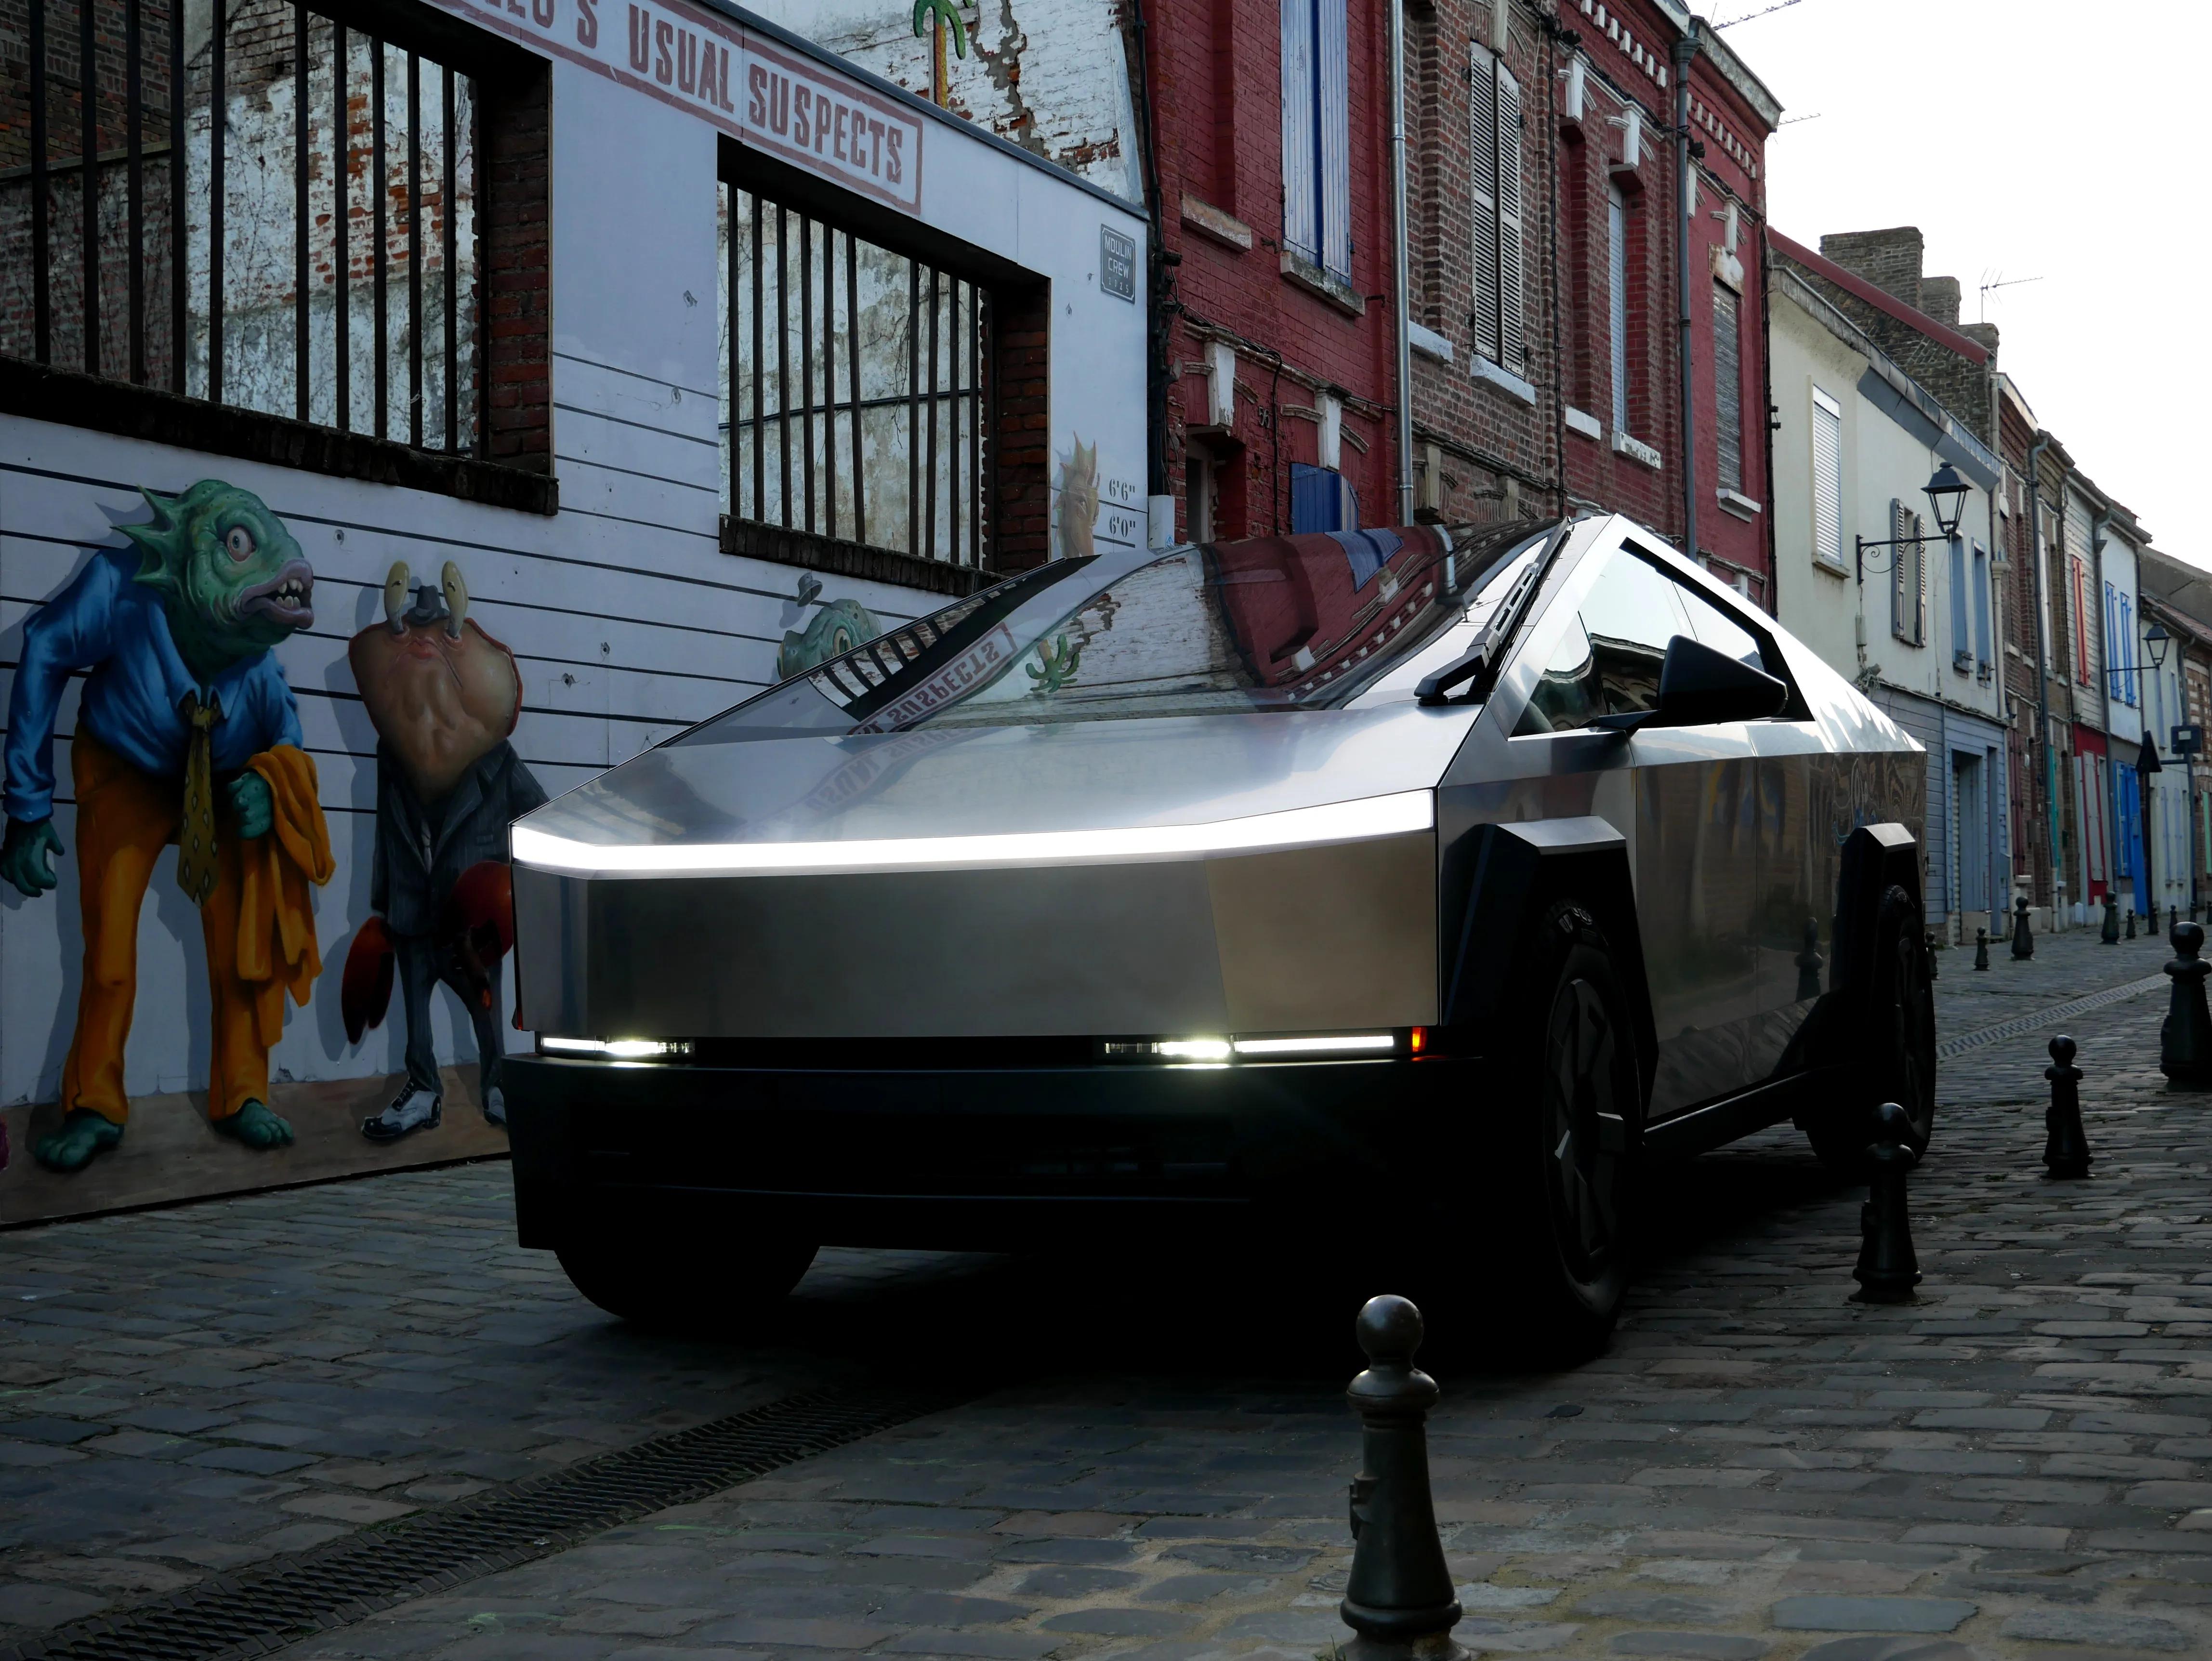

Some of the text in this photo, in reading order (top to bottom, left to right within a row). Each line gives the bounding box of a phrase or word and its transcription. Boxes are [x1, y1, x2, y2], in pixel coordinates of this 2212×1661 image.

[629, 3, 734, 114] USUAL
[749, 63, 902, 184] SUSPECTS
[1105, 235, 1132, 260] MOULIN
[1108, 257, 1129, 279] CREW
[1258, 406, 1270, 428] 56
[1109, 478, 1135, 501] 6'6"
[1109, 515, 1136, 538] 6'0"
